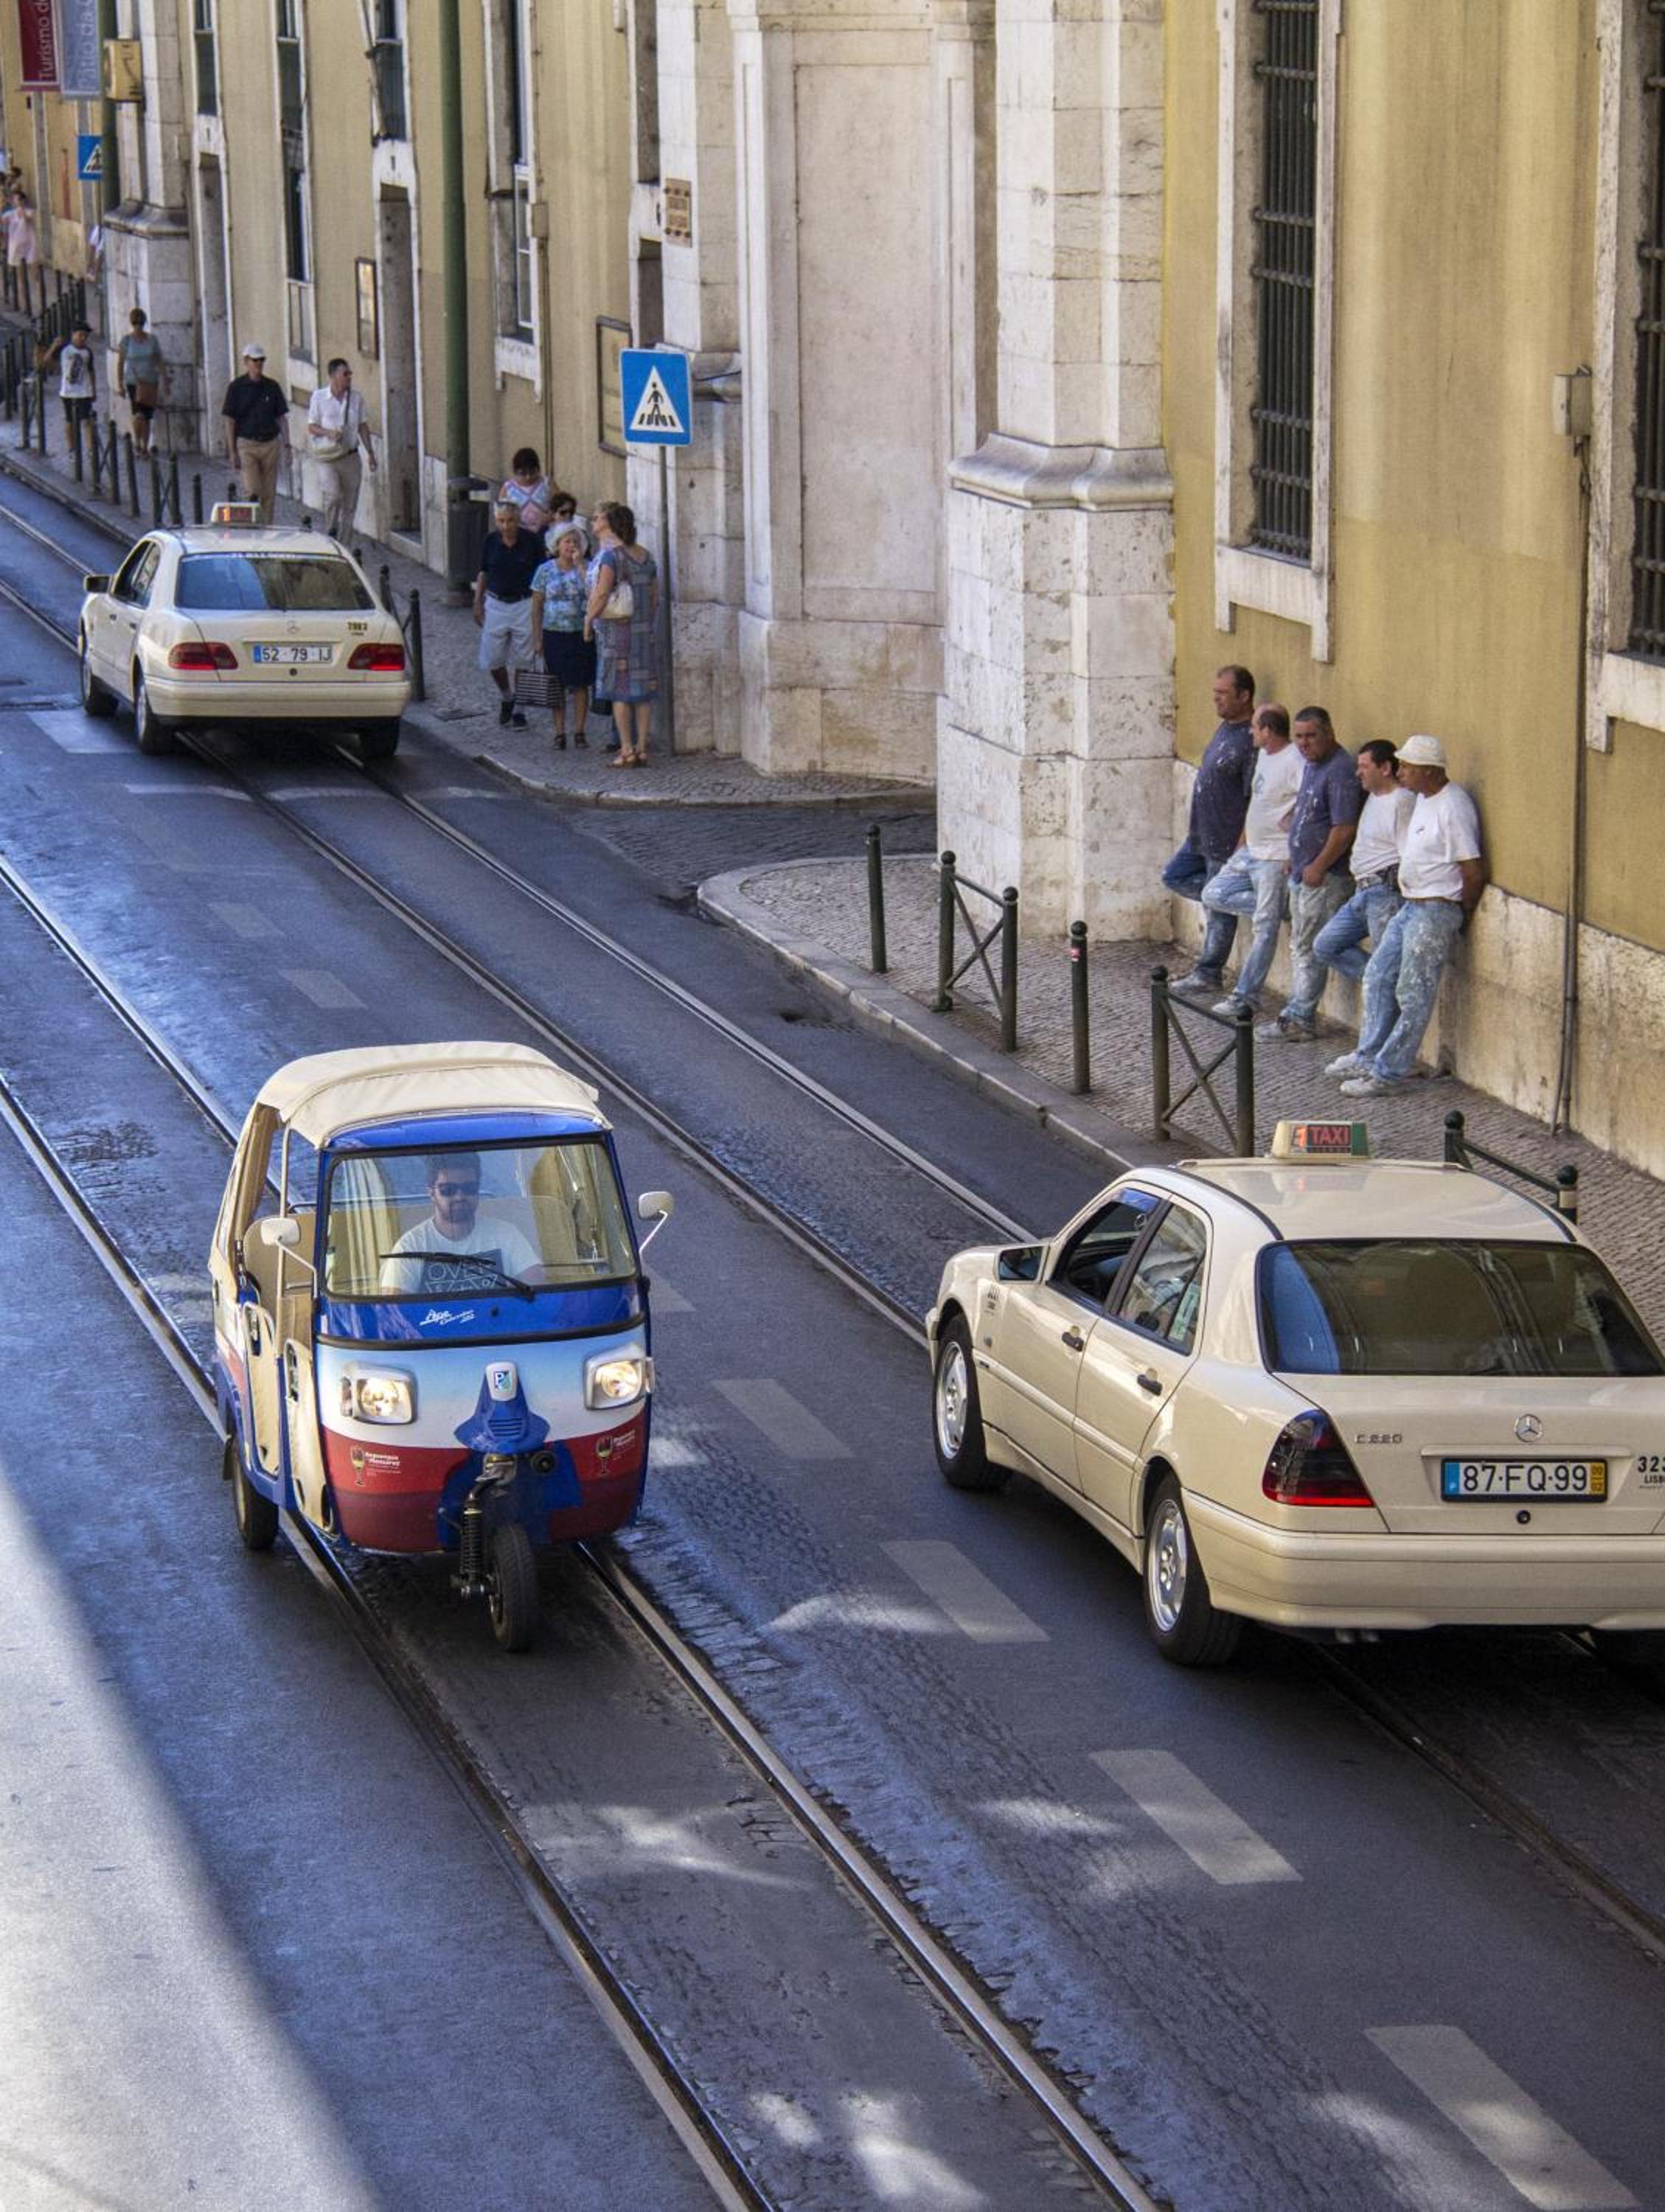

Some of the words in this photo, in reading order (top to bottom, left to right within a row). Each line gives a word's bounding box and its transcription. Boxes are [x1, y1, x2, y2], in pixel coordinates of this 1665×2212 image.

[34, 0, 50, 13] d
[37, 16, 53, 80] Turismo
[262, 648, 279, 661] 52
[291, 648, 307, 661] 79
[1310, 1126, 1349, 1145] TAXI
